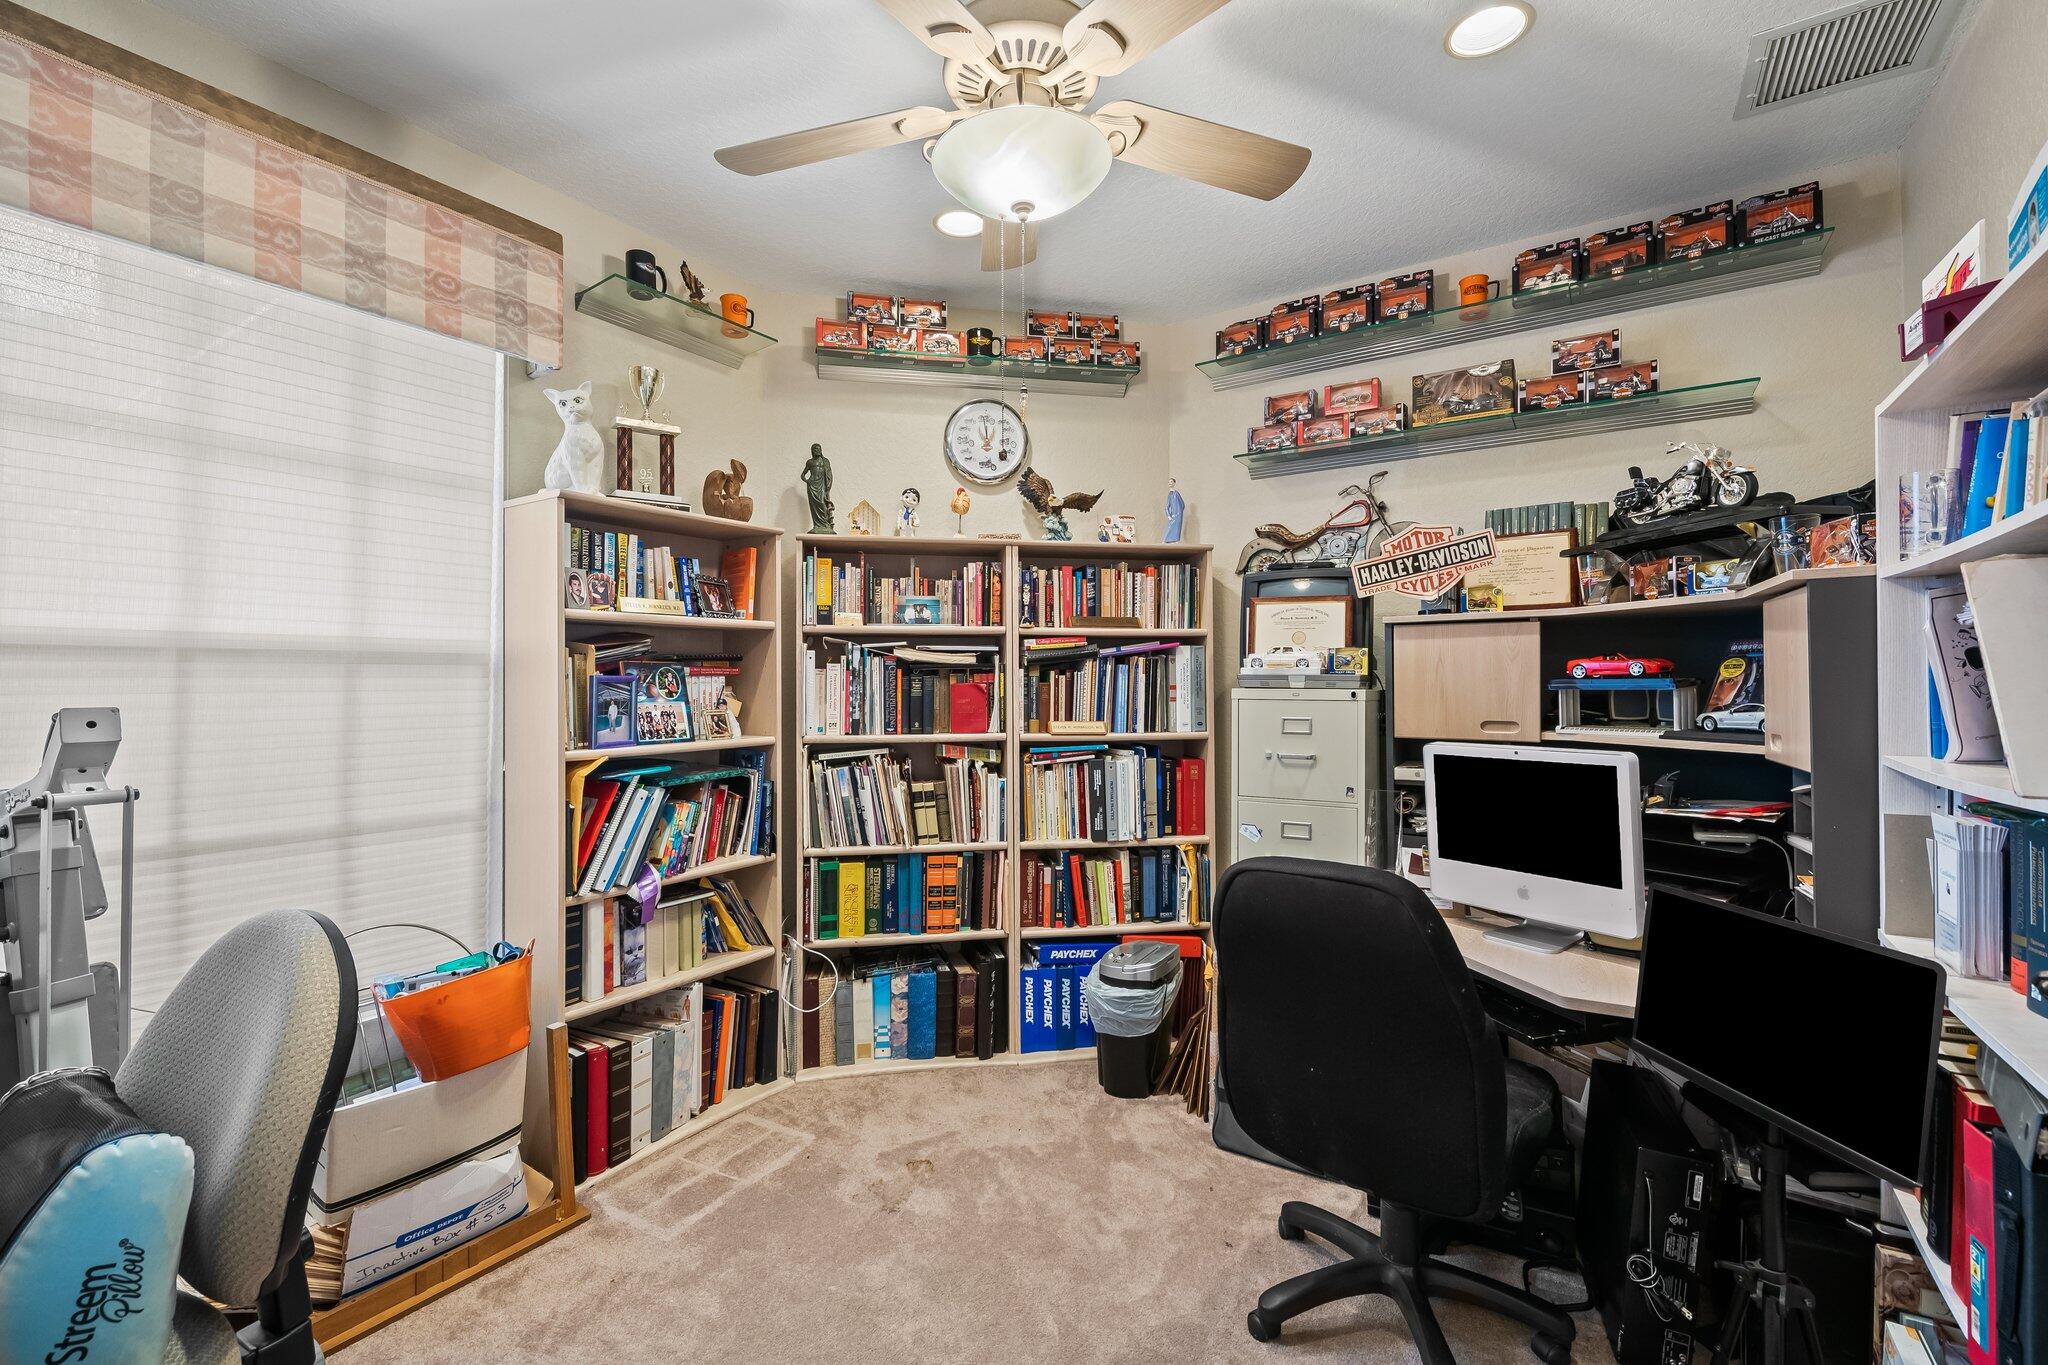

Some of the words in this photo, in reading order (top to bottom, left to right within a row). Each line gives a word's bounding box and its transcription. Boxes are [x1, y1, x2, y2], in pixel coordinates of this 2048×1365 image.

[1754, 234, 1780, 244] DIE-CAST
[1780, 227, 1805, 239] REPLICA
[1390, 530, 1446, 554] MOTOR
[1360, 537, 1491, 586] HARLEY-DAVIDSON
[1464, 560, 1493, 572] MARK
[1363, 584, 1393, 595] TRADE
[1400, 569, 1454, 593] CYCLES
[888, 665, 897, 699] CHAPMAN
[888, 699, 897, 728] PILOTING
[873, 867, 881, 909] STEDMAN'S
[1050, 949, 1099, 959] PAYCHEX
[1025, 977, 1033, 1024] PAYCHEX
[1043, 978, 1052, 1029] PAYCHEX
[1061, 978, 1071, 1029] PAYCHEX
[404, 1226, 435, 1242] Office
[437, 1213, 464, 1229] DEPOT
[356, 1245, 427, 1283] Inactive
[432, 1228, 462, 1247] Box
[45, 1262, 117, 1365] Streem
